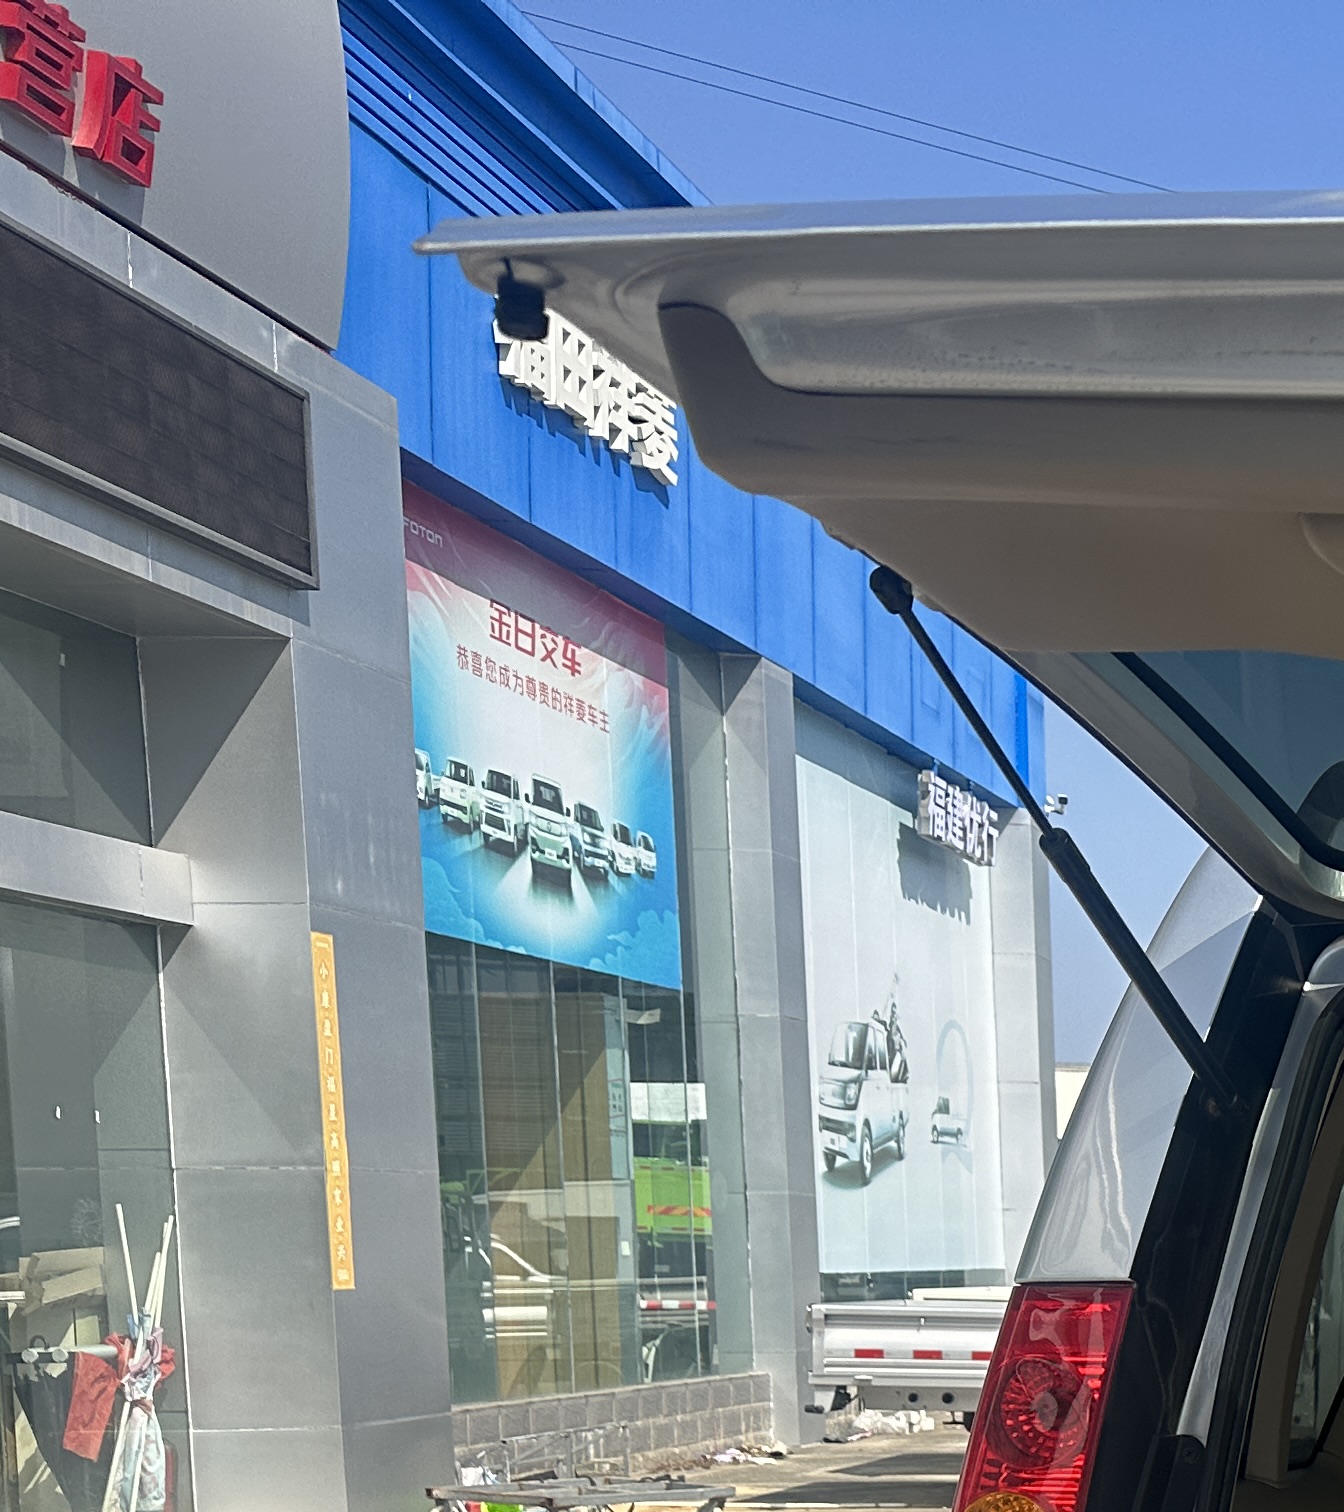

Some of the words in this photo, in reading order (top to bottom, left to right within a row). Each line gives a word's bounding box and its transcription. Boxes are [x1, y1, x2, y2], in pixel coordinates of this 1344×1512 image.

[456, 643, 611, 734] 恭喜您成为尊贵的祥菱车主
[927, 772, 1000, 866] 福建优行
